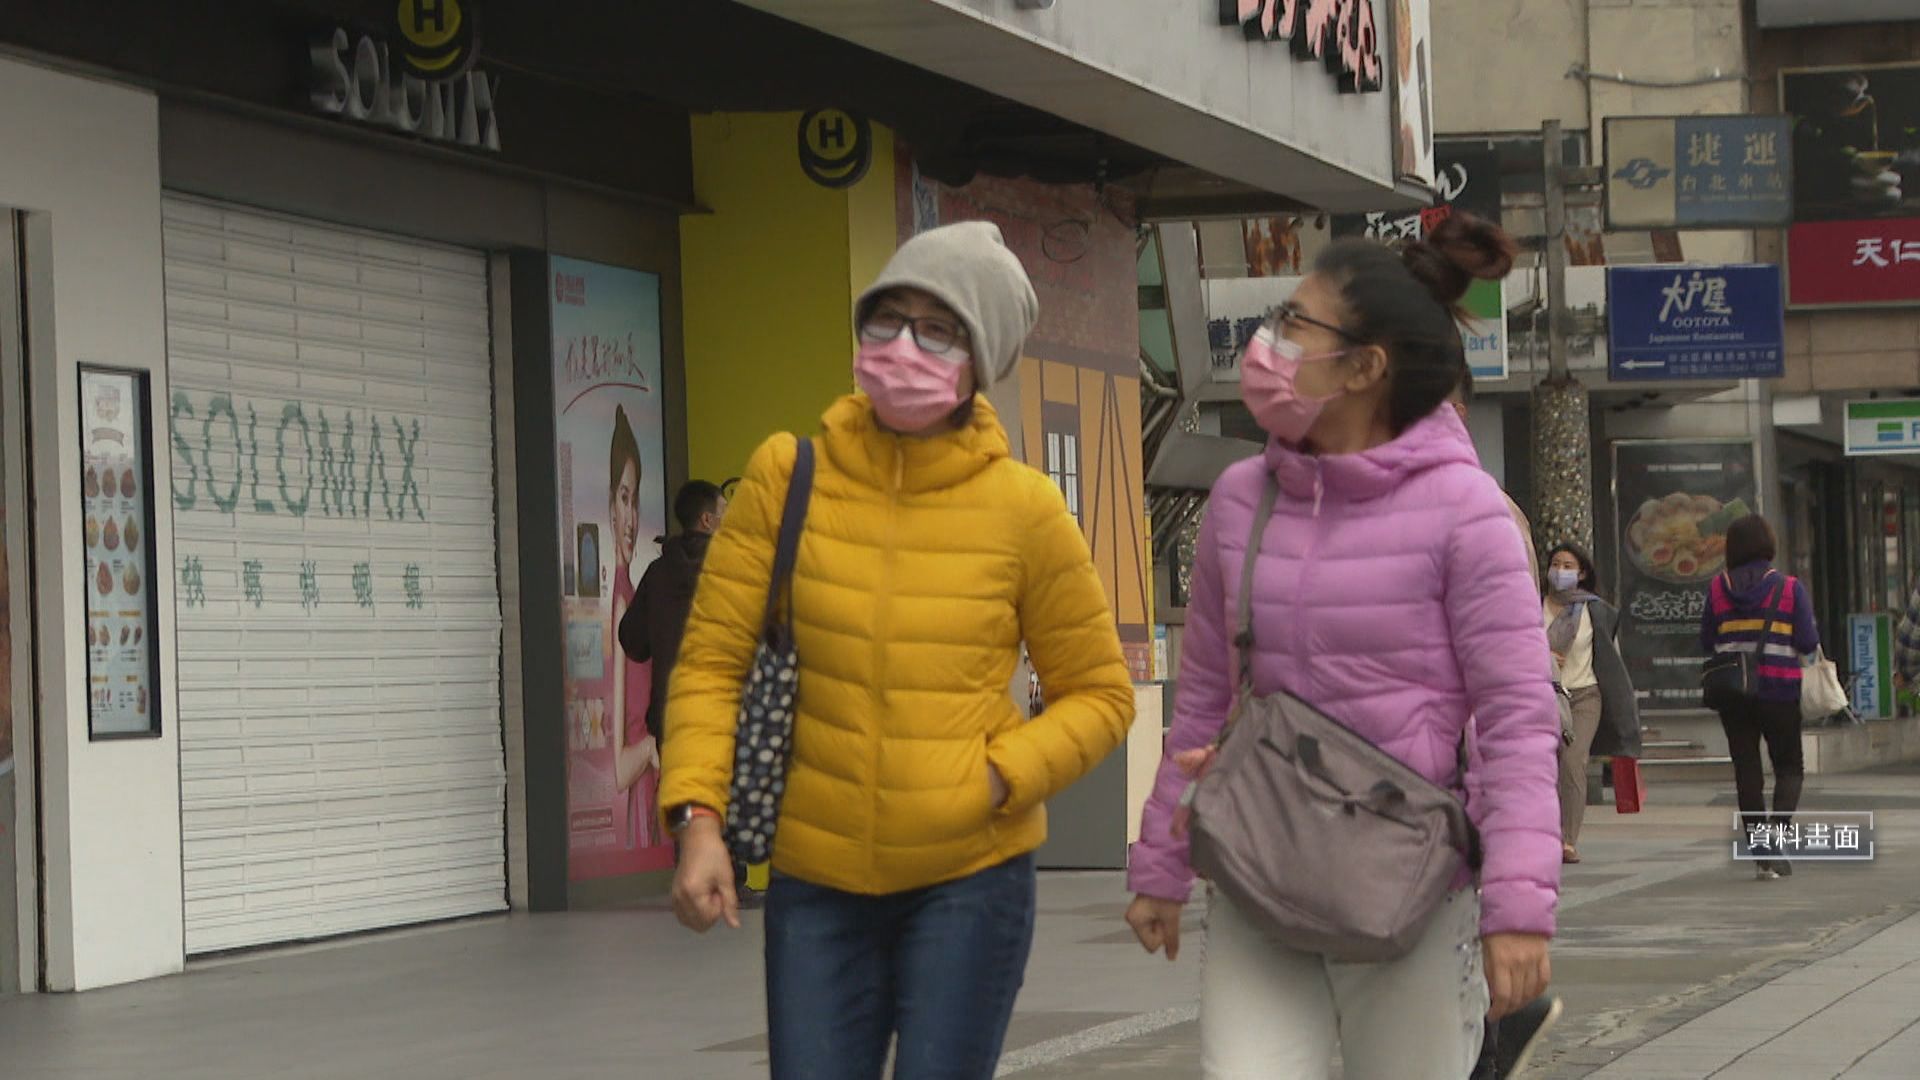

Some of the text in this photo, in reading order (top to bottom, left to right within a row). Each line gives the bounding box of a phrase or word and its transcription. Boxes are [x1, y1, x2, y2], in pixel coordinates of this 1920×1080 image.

[1688, 132, 1777, 167] 捷運
[1852, 238, 1920, 267] 天仁
[1672, 317, 1730, 328] OOTOYA
[172, 391, 424, 521] SOLOMAX
[1856, 624, 1874, 710] FamilyMart
